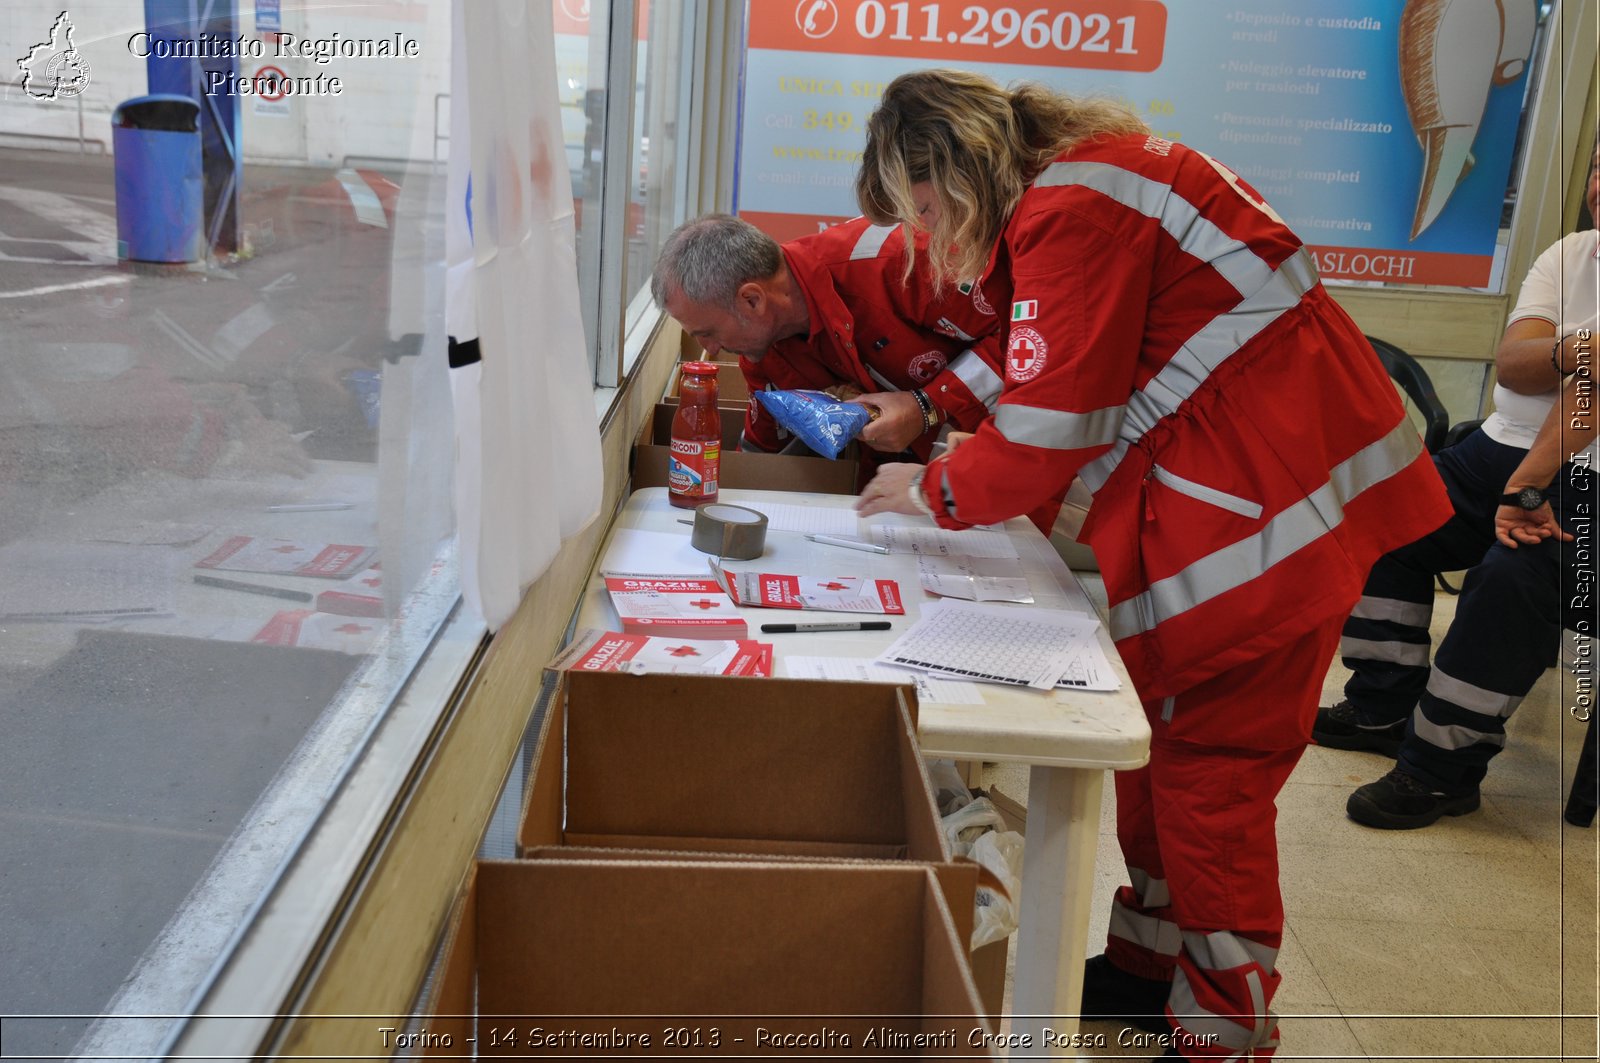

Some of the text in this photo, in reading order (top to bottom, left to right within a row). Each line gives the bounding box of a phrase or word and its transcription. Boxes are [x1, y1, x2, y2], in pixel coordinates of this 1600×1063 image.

[855, 0, 1138, 54] 011.296021
[1234, 11, 1382, 31] Deposito e custodia
[1232, 29, 1278, 43] arredi
[1228, 59, 1367, 80] Noleggio elevatore
[778, 75, 844, 97] UNICA
[1225, 79, 1320, 95] per traslochi
[765, 112, 797, 130] Cell.
[1221, 112, 1392, 134] Personale specializzato
[1218, 128, 1303, 148] dipendente
[1297, 168, 1361, 184] completi
[623, 580, 707, 588] GRAZIE.
[583, 639, 625, 670] GRAZIE.
